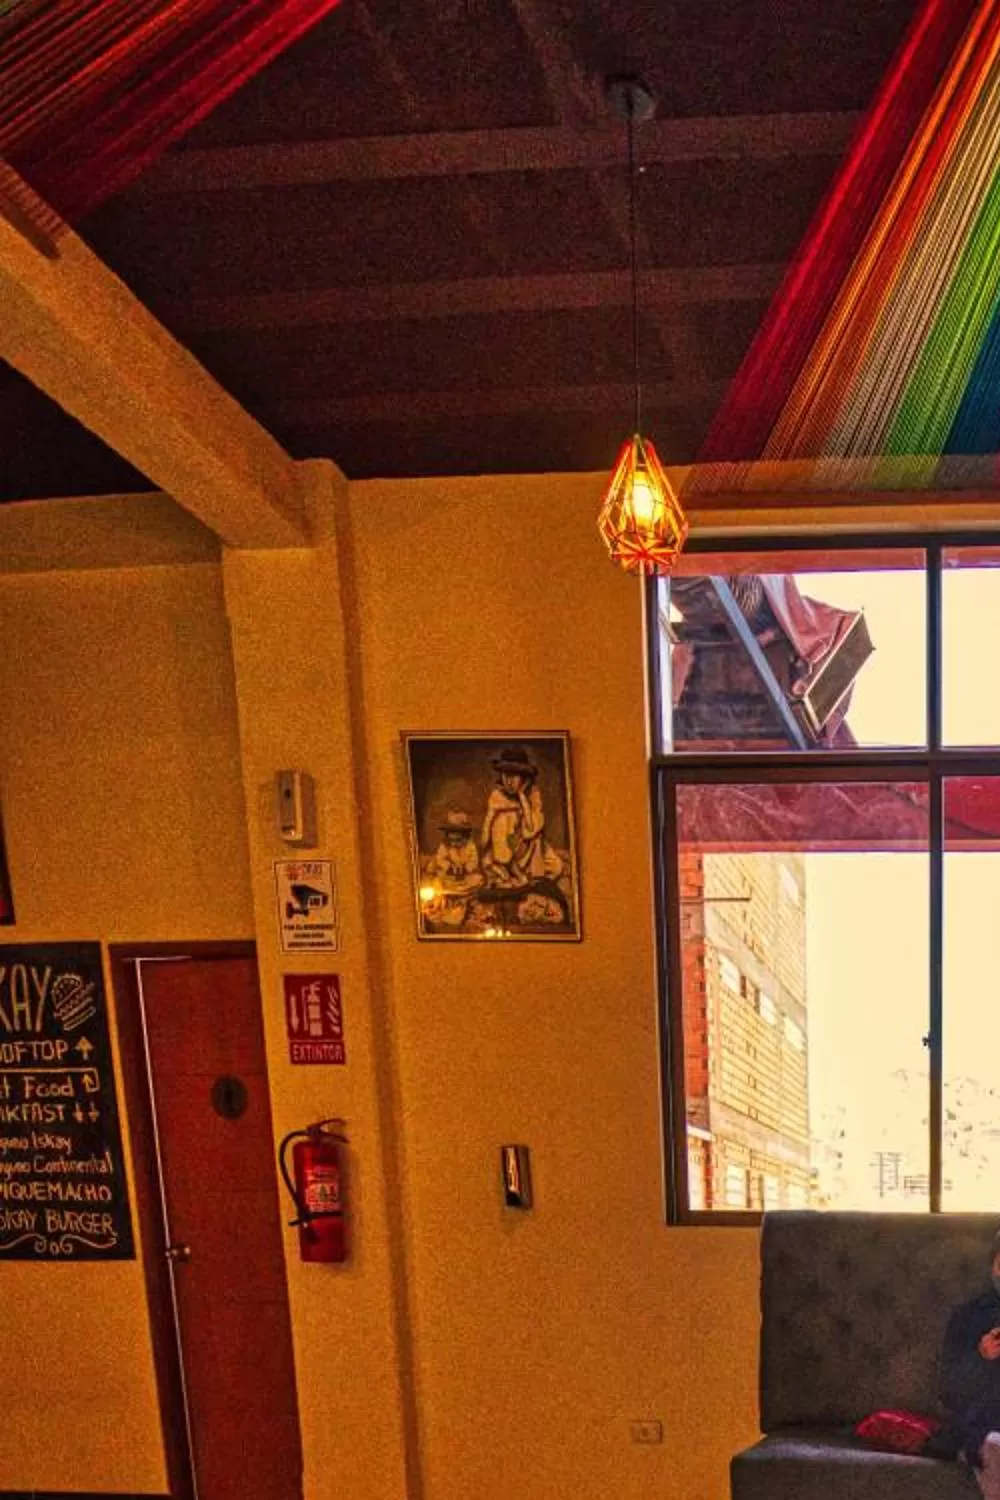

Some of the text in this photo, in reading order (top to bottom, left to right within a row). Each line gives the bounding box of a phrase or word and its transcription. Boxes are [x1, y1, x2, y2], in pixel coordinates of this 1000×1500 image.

[0, 1039, 69, 1064] OFTOP
[292, 1043, 343, 1061] EXTINTOR
[45, 1207, 118, 1239] BURGER
